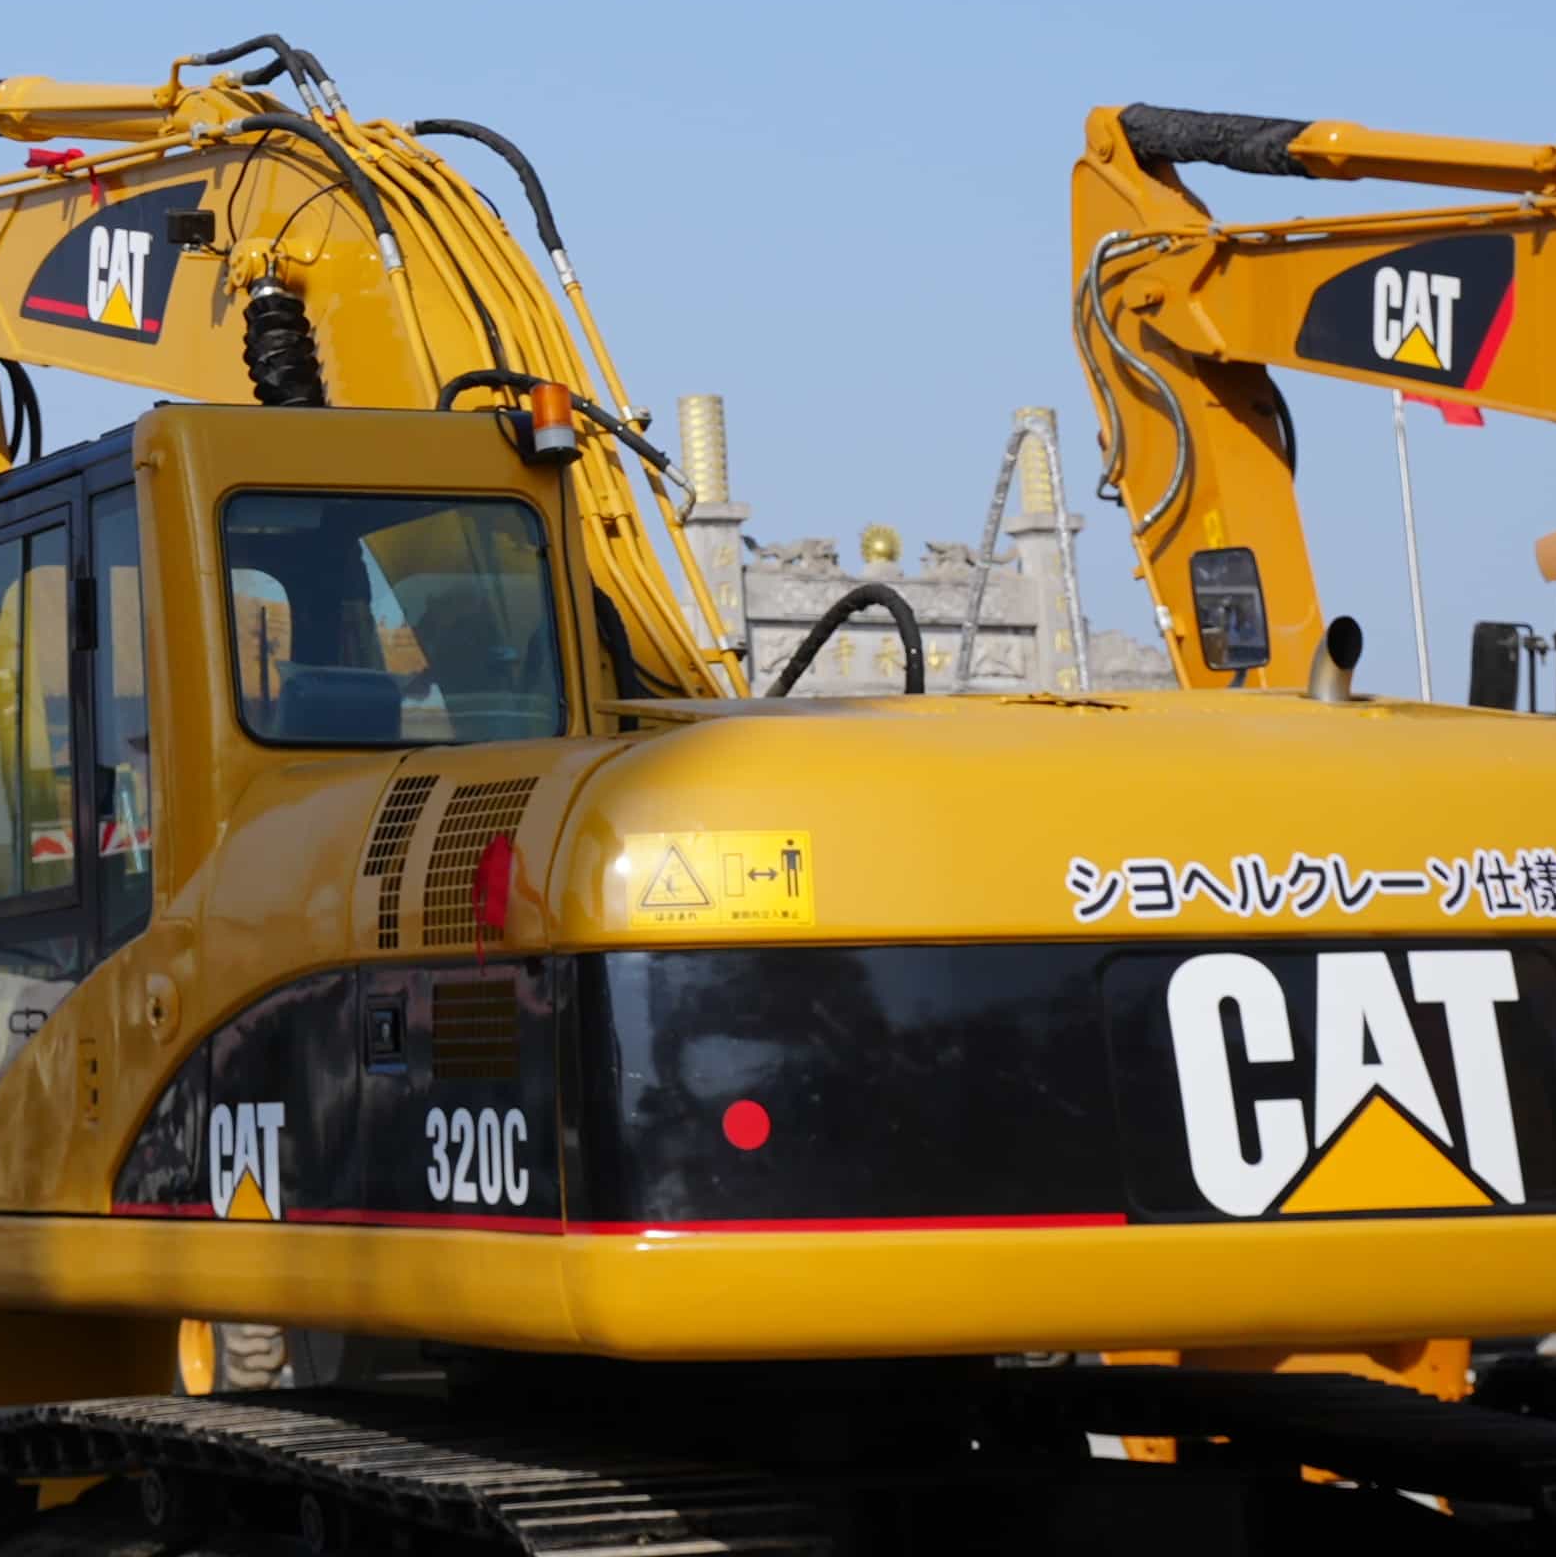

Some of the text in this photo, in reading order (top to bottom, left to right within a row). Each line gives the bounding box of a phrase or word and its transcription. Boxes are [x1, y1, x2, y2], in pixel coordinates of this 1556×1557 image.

[87, 224, 154, 331] CAT
[1372, 265, 1461, 371] CAT
[1166, 950, 1526, 1217] CAT
[209, 1101, 285, 1221] CAT
[426, 1106, 529, 1206] 320C
